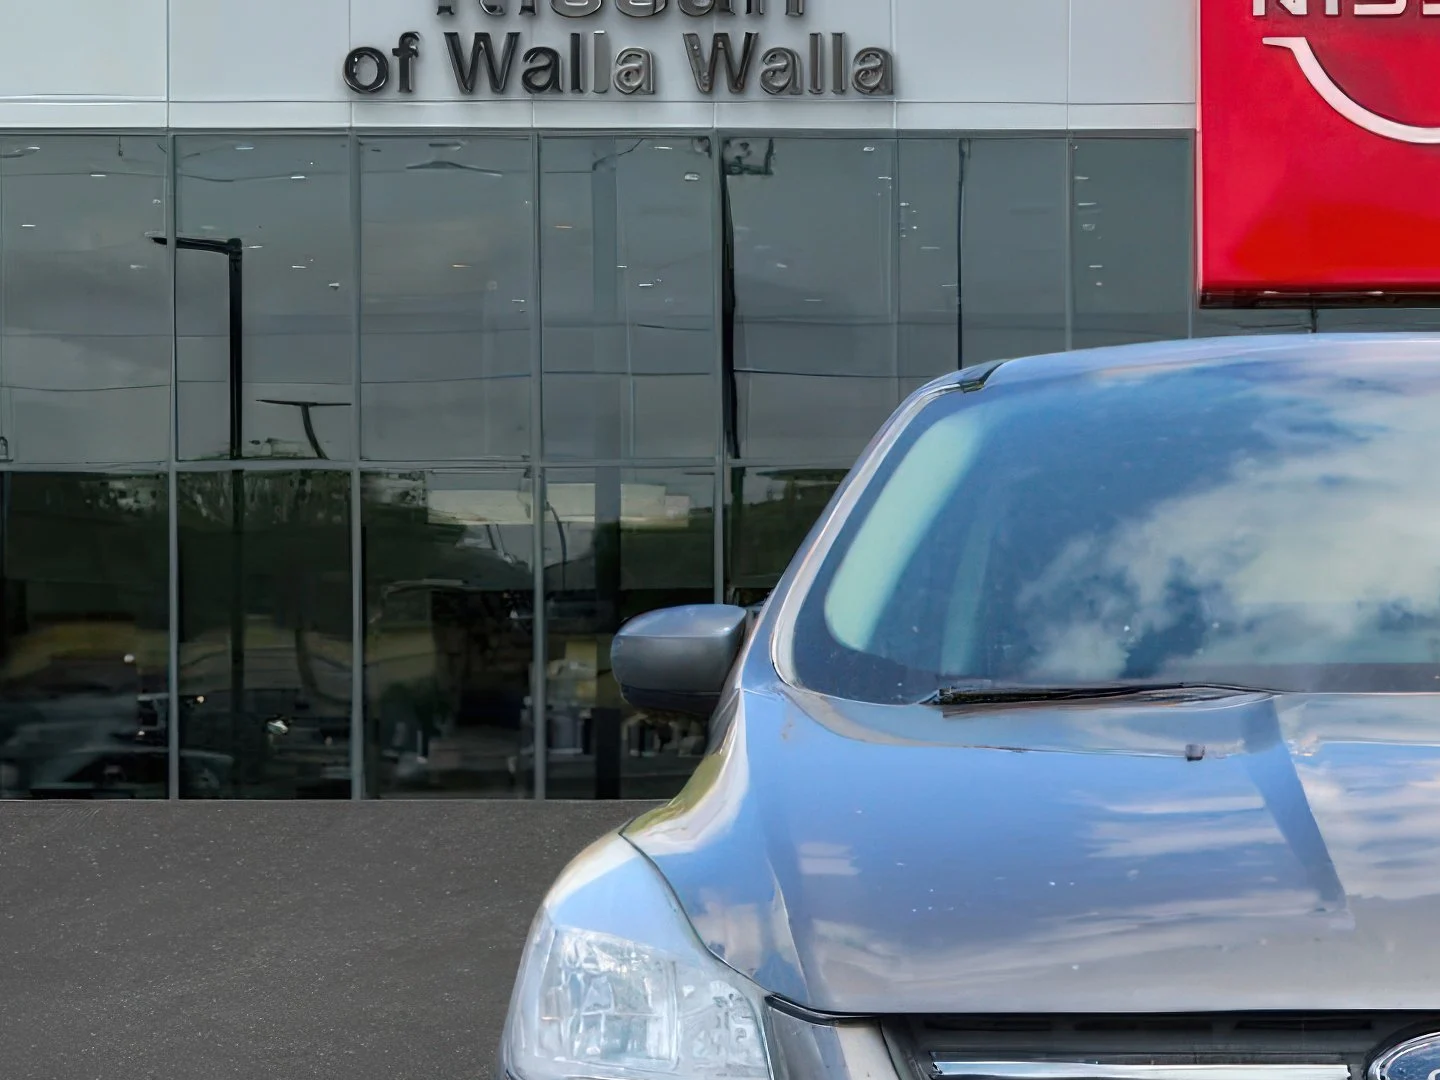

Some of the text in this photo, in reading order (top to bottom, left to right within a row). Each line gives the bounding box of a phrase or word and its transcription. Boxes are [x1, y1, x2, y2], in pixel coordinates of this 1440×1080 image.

[343, 31, 895, 96] of Walla Walla
